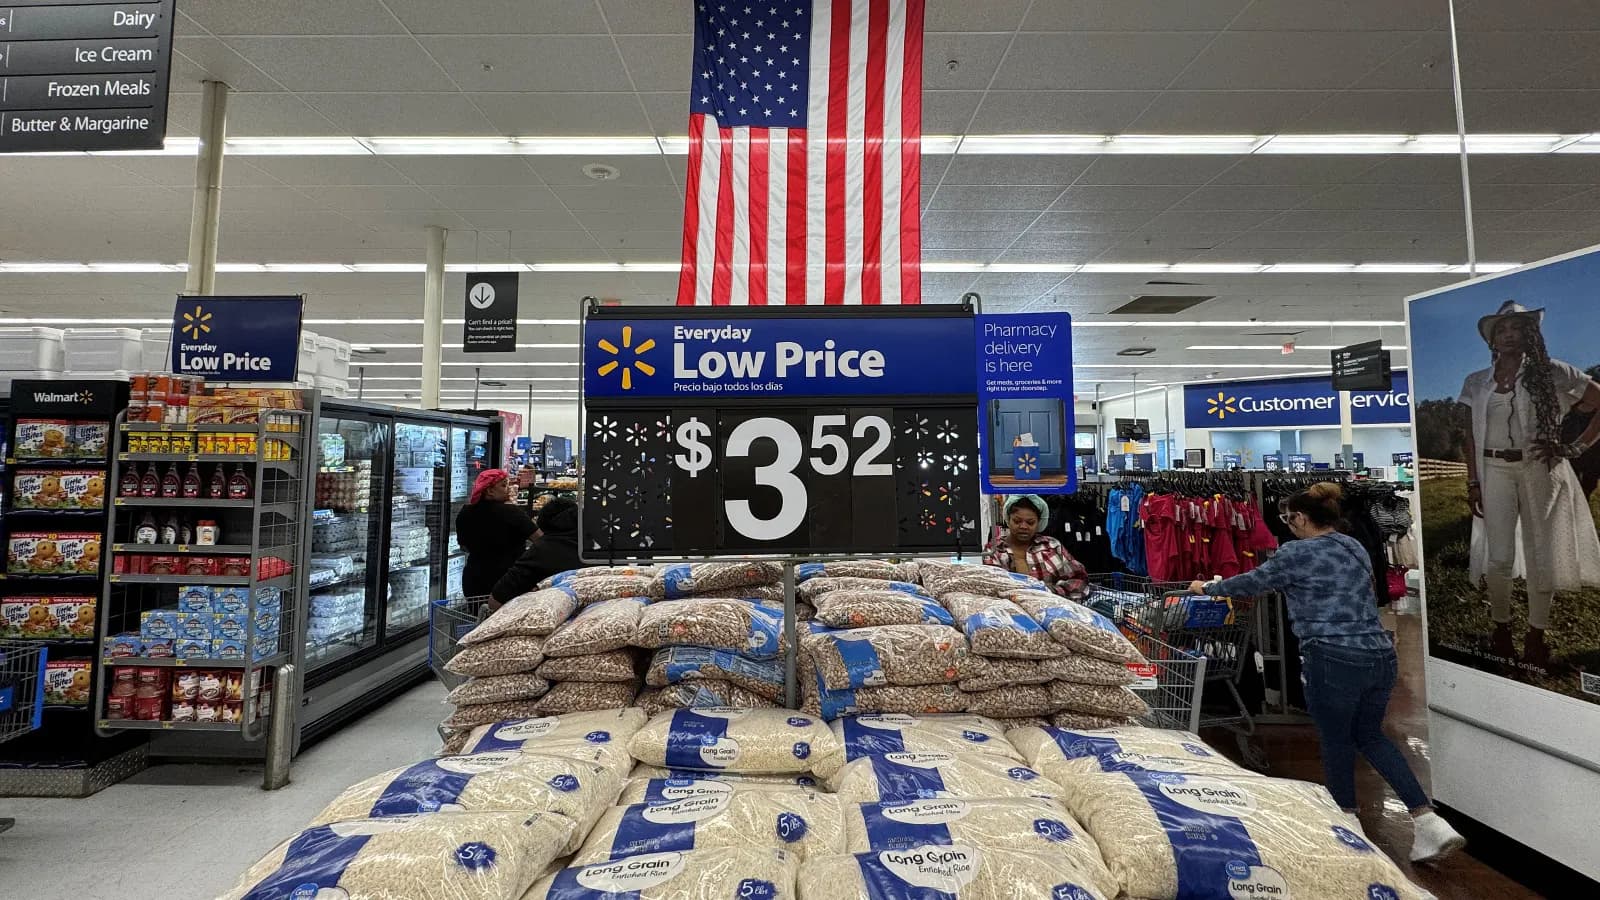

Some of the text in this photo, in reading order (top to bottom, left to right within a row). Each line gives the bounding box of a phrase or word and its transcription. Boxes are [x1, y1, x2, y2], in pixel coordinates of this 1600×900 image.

[113, 11, 155, 29] Dairy
[75, 46, 152, 62] Ice Cream
[48, 80, 150, 97] Frozen Meals
[12, 116, 149, 133] Butter & Margarine
[674, 325, 752, 343] Everyday
[984, 322, 1056, 338] Pharmacy
[180, 344, 217, 352] Everyday
[984, 340, 1042, 357] delivery
[180, 352, 272, 370] Low Price
[674, 340, 885, 378] Low Price
[986, 358, 1032, 372] is here
[674, 382, 783, 393] Precio bajo todos los días
[34, 392, 78, 402] Walmart
[1238, 390, 1410, 412] Customer ervic
[19, 478, 36, 488] Little
[64, 477, 82, 489] Little
[24, 485, 40, 494] Bites
[70, 485, 86, 494] Bites
[14, 542, 30, 554] Little
[18, 548, 36, 558] Bites
[62, 542, 78, 554] Little
[66, 549, 82, 558] Bites
[6, 606, 22, 618] Little
[10, 613, 28, 622] Bites
[56, 606, 72, 617] Little
[61, 613, 77, 622] Bites
[1484, 652, 1506, 664] store
[1508, 658, 1515, 666] &
[50, 671, 66, 682] Little
[54, 678, 72, 688] Bites
[1117, 752, 1145, 761] Long
[1165, 786, 1240, 799] Long Grain
[650, 797, 718, 813] Long Grain
[887, 851, 966, 865] Long Grain
[586, 860, 670, 877] Long Grain
[919, 864, 970, 876] Enriched Rice
[612, 871, 647, 880] Enriched
[1232, 882, 1281, 894] Long Grain
